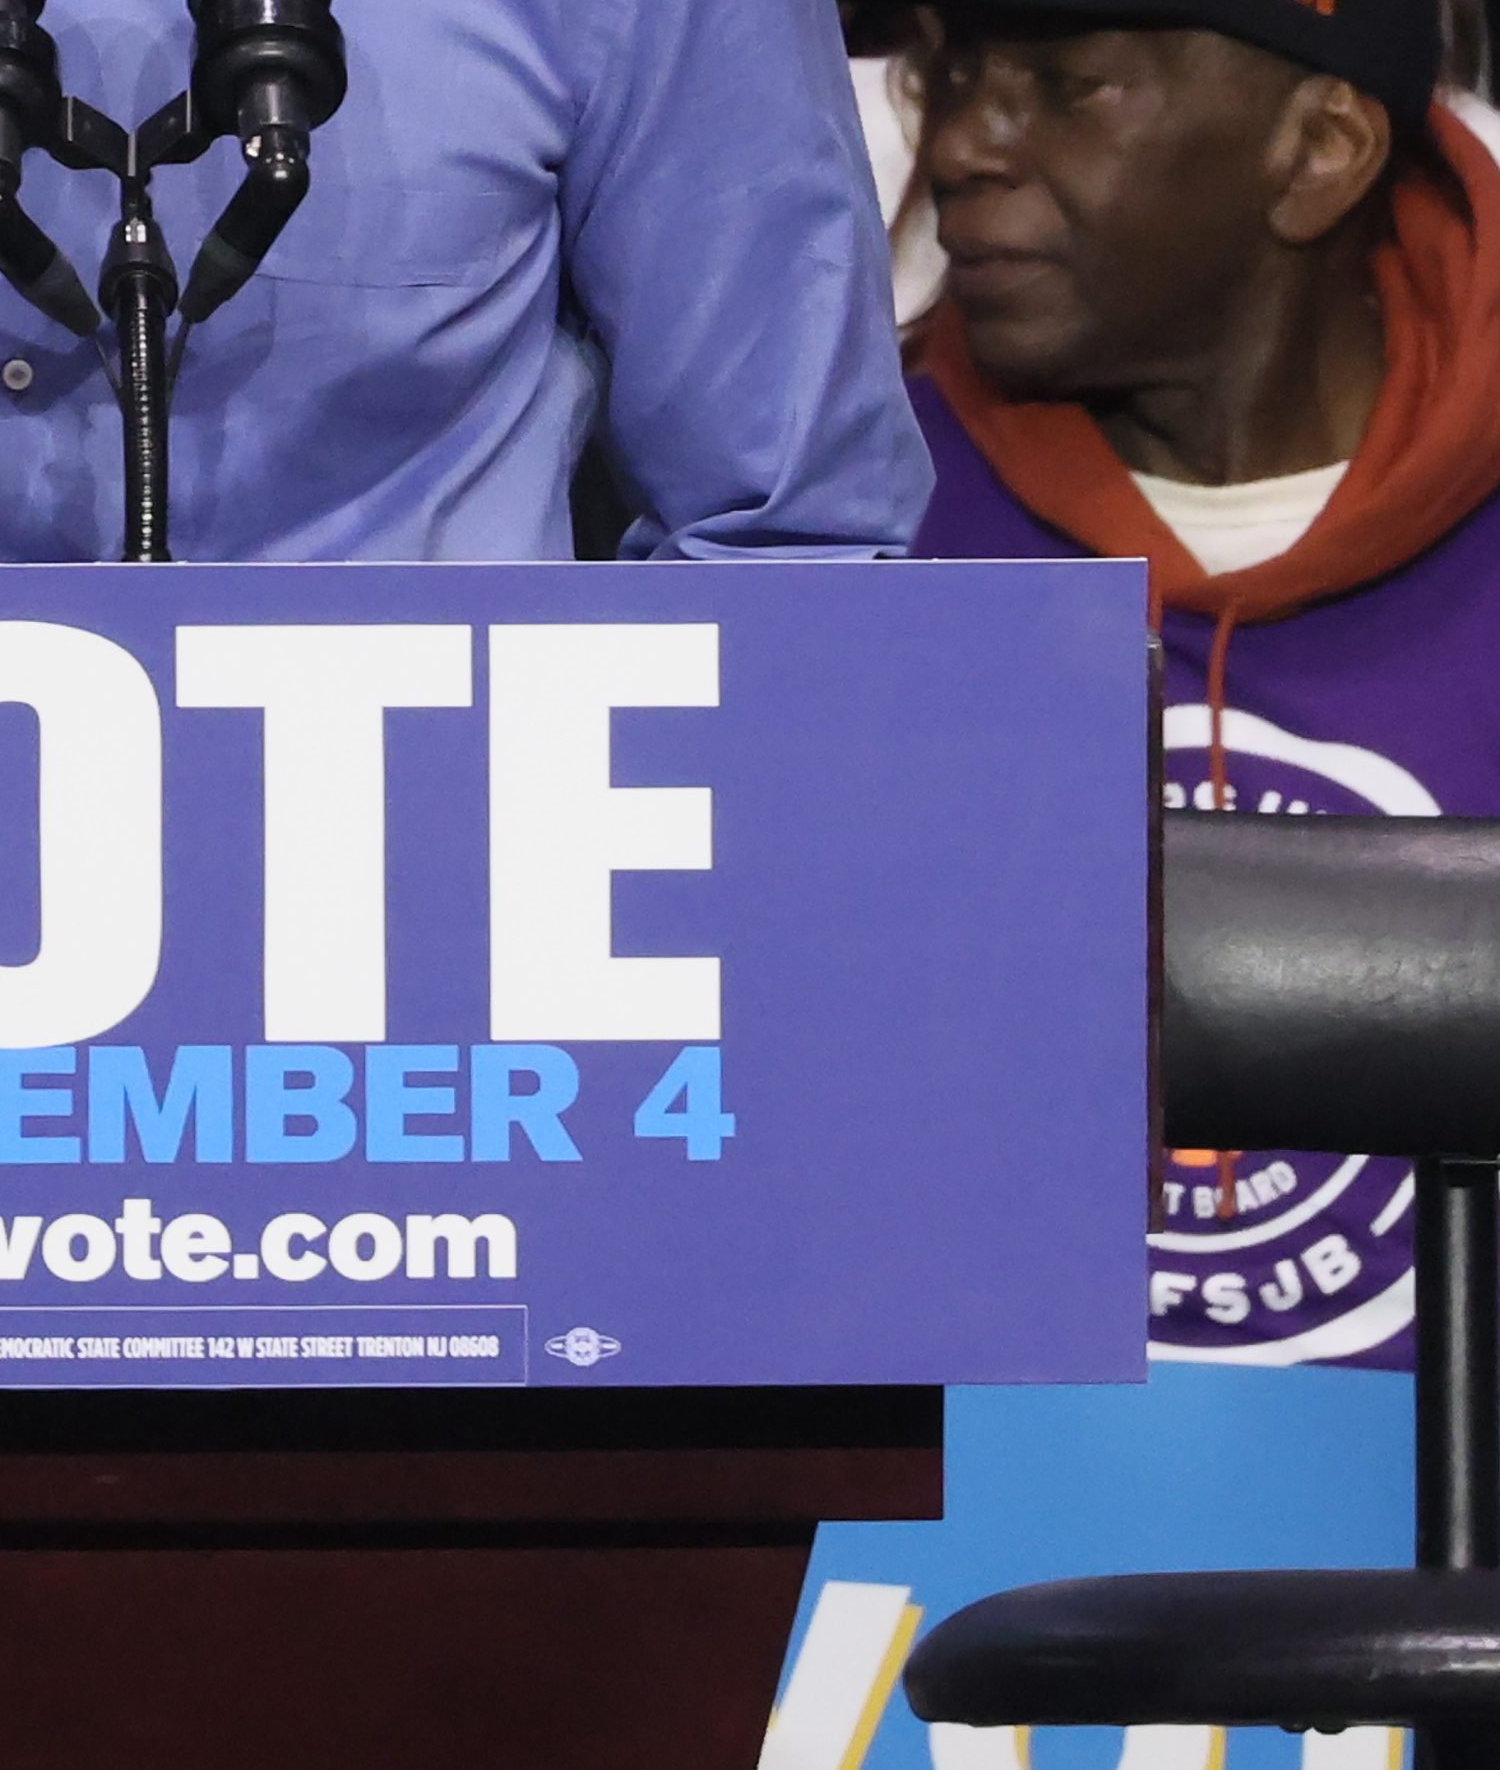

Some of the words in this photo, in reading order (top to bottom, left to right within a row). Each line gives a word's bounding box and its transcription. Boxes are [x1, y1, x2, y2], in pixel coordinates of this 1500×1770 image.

[633, 1044, 737, 1162] 4
[77, 1337, 121, 1359] STATE
[122, 1337, 205, 1359] COMMITTEE
[207, 1336, 235, 1358] 142
[236, 1336, 255, 1358] W
[255, 1336, 299, 1358] STATE
[300, 1336, 354, 1358] STREET
[356, 1335, 425, 1357] TRENTON
[426, 1335, 448, 1357] NJ
